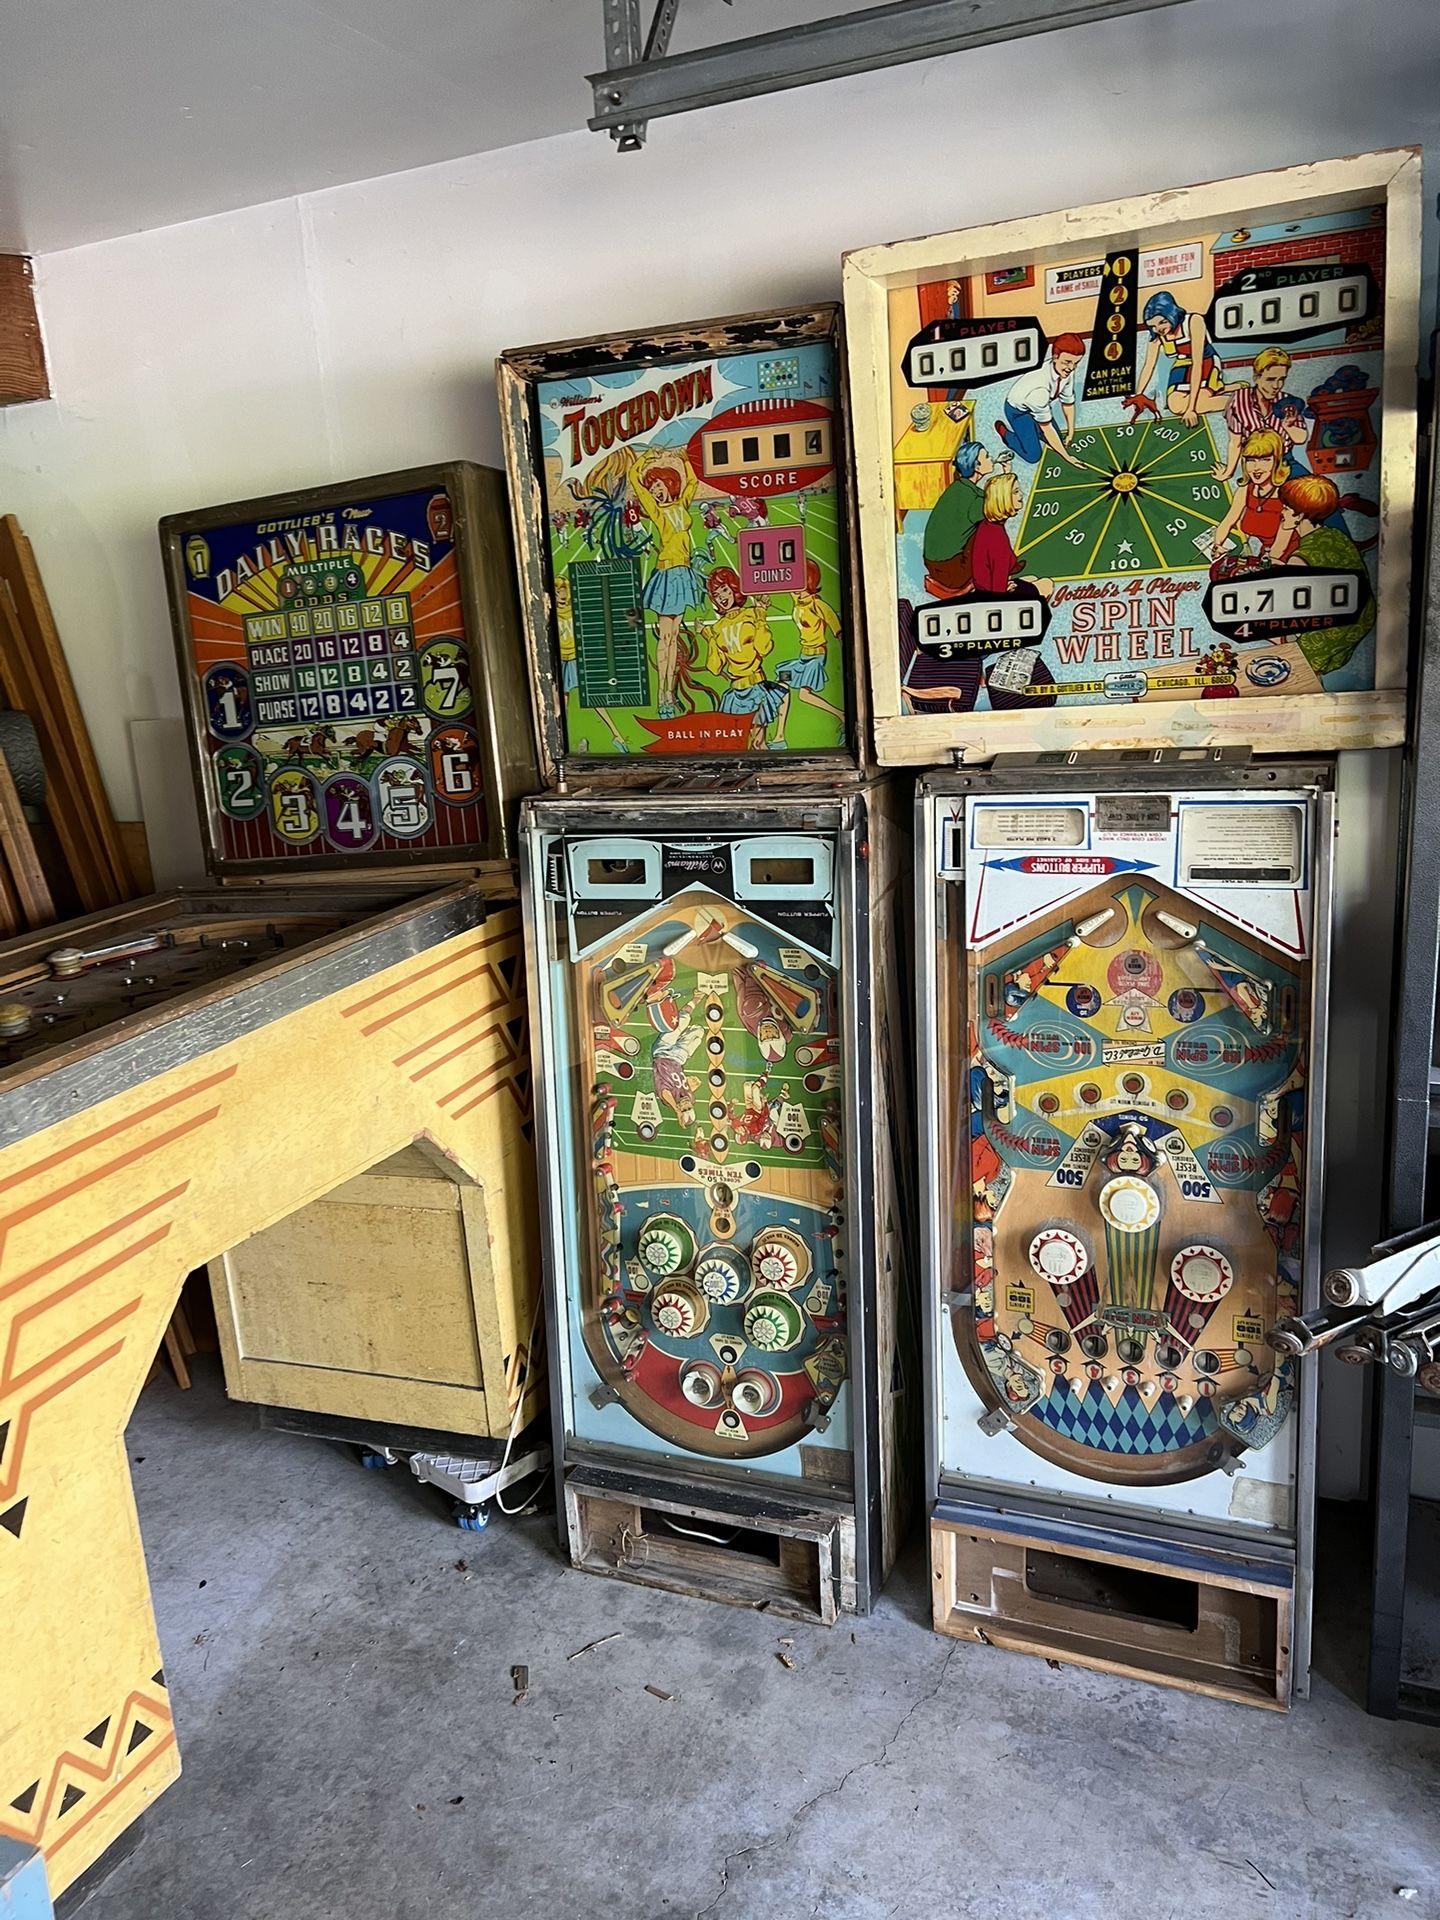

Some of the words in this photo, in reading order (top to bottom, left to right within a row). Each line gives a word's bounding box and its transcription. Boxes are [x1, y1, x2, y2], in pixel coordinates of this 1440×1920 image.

[1117, 258, 1126, 275] 1
[1143, 259, 1157, 268] IT'S
[1158, 255, 1177, 266] MORE
[1179, 252, 1195, 263] FUN
[1063, 267, 1101, 280] PLAYERS
[1146, 269, 1155, 277] TO
[1277, 267, 1344, 286] PLAYER
[1050, 287, 1055, 295] A
[1056, 284, 1073, 295] GAME
[1081, 280, 1099, 291] SKILL
[1113, 287, 1125, 303] 2
[960, 319, 1017, 337] PLAYER
[1110, 316, 1122, 332] 3
[1106, 343, 1119, 359] 4
[1090, 369, 1108, 380] CAN
[1110, 366, 1132, 378] PLAY
[1086, 385, 1109, 397] SAME
[1111, 382, 1132, 394] TIME
[559, 394, 603, 408] Williams
[560, 365, 714, 469] TOUCHDOWN
[1116, 425, 1135, 438] 50
[1153, 426, 1180, 442] 400
[1070, 434, 1096, 454] 300
[1190, 449, 1207, 462] 50
[738, 471, 798, 490] SCORE
[1045, 466, 1062, 479] 50
[1192, 484, 1221, 501] 500
[1032, 501, 1060, 518] 200
[256, 512, 335, 535] GOTTLIEB'S
[664, 507, 688, 535] W
[1165, 517, 1188, 537] 50
[1064, 528, 1086, 546] 50
[286, 558, 351, 577] MULTIPLE
[1110, 557, 1141, 571] 100
[305, 580, 316, 593] 2
[326, 576, 337, 589] 3
[347, 572, 358, 586] 4
[752, 568, 793, 583] POINTS
[1122, 579, 1144, 596] 4
[1146, 577, 1202, 600] Player
[293, 592, 348, 609] ODDS
[249, 618, 283, 639] WIN
[290, 613, 307, 634] 40
[314, 610, 332, 630] 20
[338, 606, 356, 628] 16
[362, 603, 382, 625] 12
[390, 600, 405, 621] 8
[1072, 596, 1179, 633] SPIN
[1269, 616, 1335, 630] PLAYER
[720, 620, 743, 654] W
[967, 638, 1022, 650] PLAYER
[251, 646, 290, 667] PLACE
[294, 643, 313, 661] 20
[317, 640, 335, 658] 16
[342, 637, 360, 656] 12
[367, 633, 383, 652] 8
[393, 630, 410, 648] 4
[1053, 627, 1202, 665] WHEEL
[255, 673, 290, 693] SHOW
[298, 670, 316, 688] 16
[320, 667, 338, 686] 12
[347, 665, 362, 683] 8
[371, 662, 388, 680] 4
[396, 659, 412, 677] 2
[431, 666, 461, 711] 7
[1057, 683, 1085, 693] GOTTLIEB
[1086, 683, 1092, 691] &
[218, 690, 243, 730] 1
[258, 700, 297, 722] PURSE
[300, 697, 319, 718] 12
[326, 694, 342, 715] 8
[349, 692, 367, 712] 4
[374, 689, 390, 709] 2
[400, 687, 416, 707] 2
[667, 730, 695, 741] BALL
[699, 729, 711, 739] IN
[715, 728, 744, 740] PLAY
[441, 752, 473, 794] 6
[226, 770, 256, 808] 2
[282, 793, 311, 833] 3
[388, 786, 421, 827] 5
[334, 801, 368, 840] 4
[665, 859, 710, 872] Williams
[1030, 862, 1070, 874] BUTTONS
[1072, 863, 1106, 874] FLIPPER
[1030, 1041, 1060, 1053] SPIN
[1176, 1049, 1208, 1063] SPIN
[671, 1072, 689, 1090] 26
[1118, 1114, 1138, 1122] POINTS
[1031, 1145, 1061, 1157] SPIN
[1070, 1153, 1091, 1163] RESET
[697, 1168, 724, 1177] TIMES
[1175, 1162, 1197, 1171] RESET
[1207, 1159, 1240, 1171] SPIN
[726, 1171, 743, 1179] TEN
[1056, 1169, 1084, 1186] 500
[1182, 1180, 1211, 1198] 500
[1008, 1301, 1024, 1309] POINTS
[1053, 1360, 1064, 1372] 5
[1090, 1365, 1099, 1377] 4
[1126, 1371, 1135, 1383] 3
[1163, 1378, 1173, 1391] 2
[1203, 1383, 1210, 1396] 1
